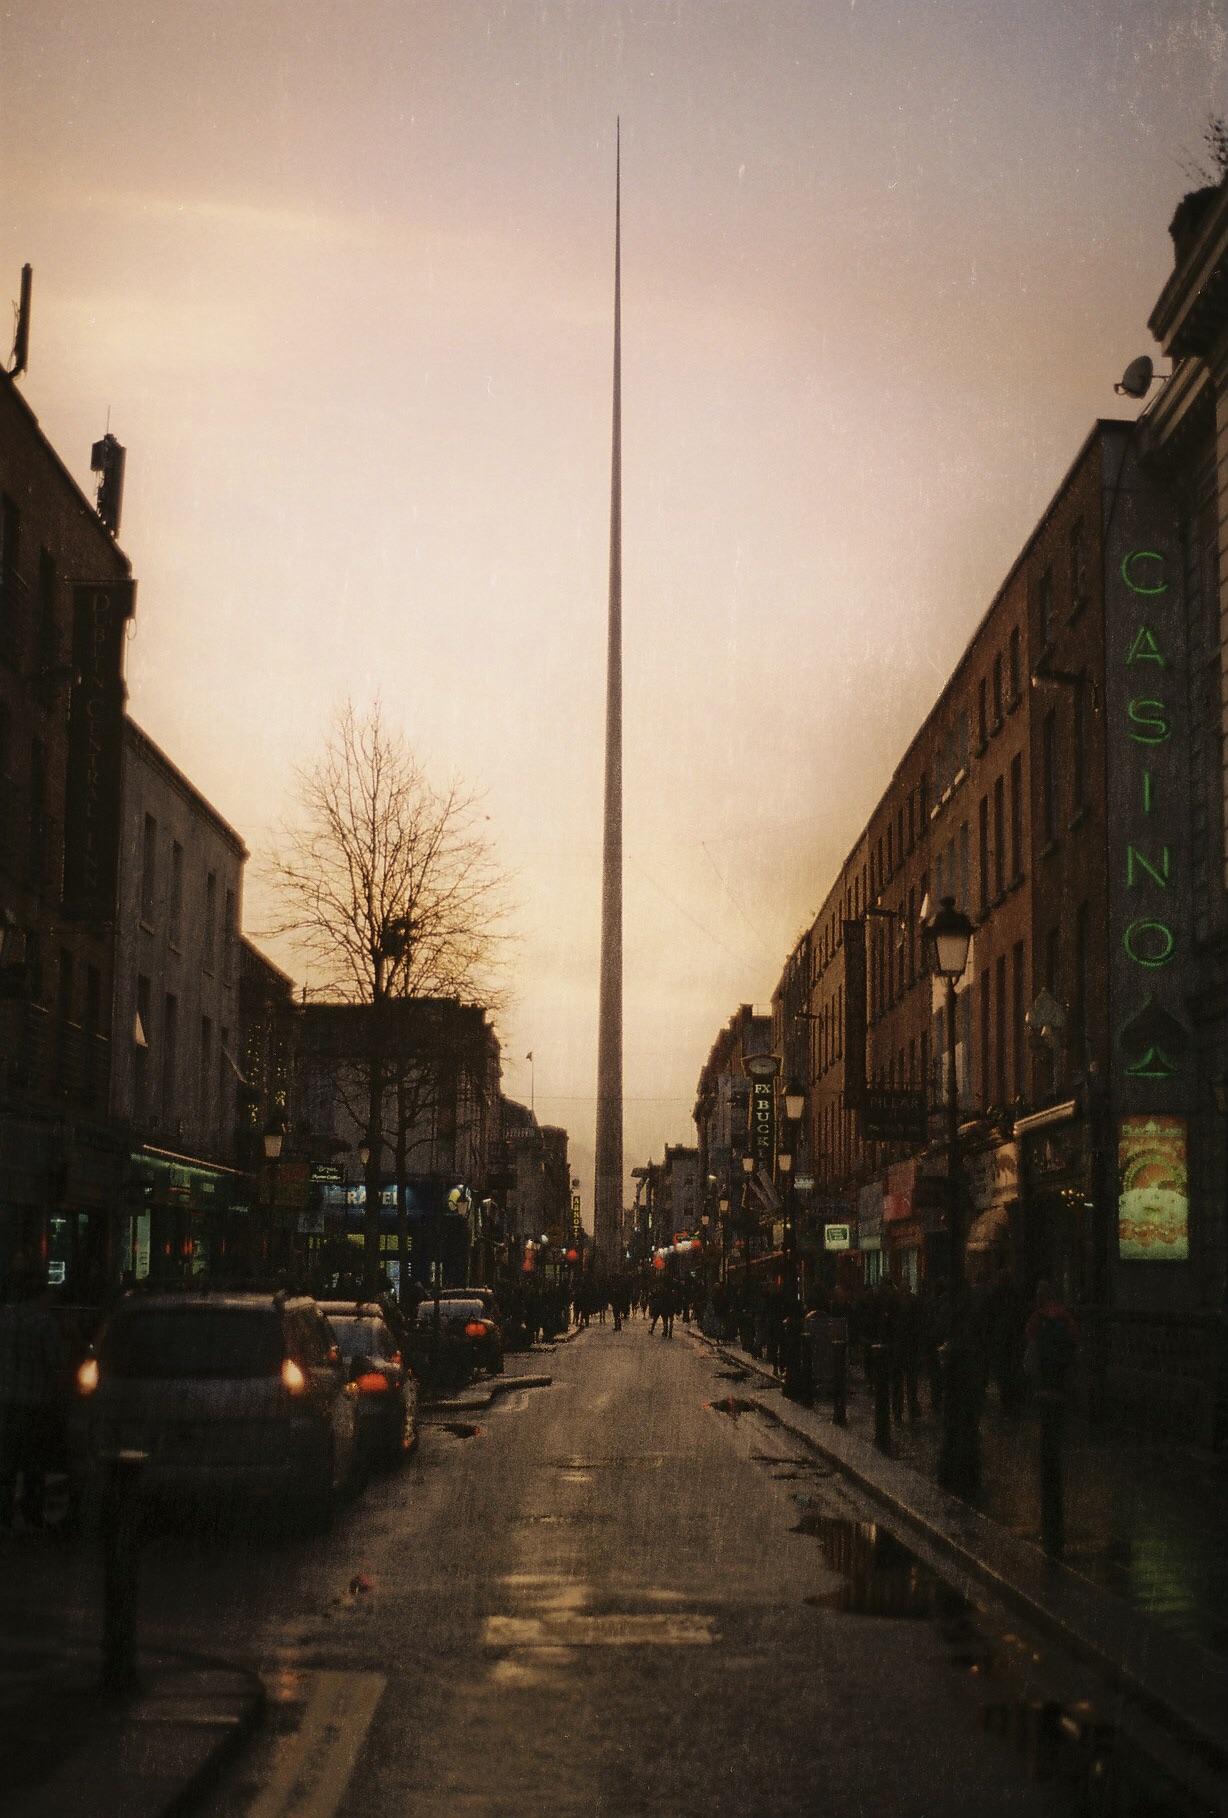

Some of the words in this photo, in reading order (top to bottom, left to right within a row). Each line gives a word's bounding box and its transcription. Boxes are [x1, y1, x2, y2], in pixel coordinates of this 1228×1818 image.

[1121, 551, 1174, 967] CASINO
[754, 1084, 771, 1093] FX
[756, 1099, 770, 1169] BUCKLE
[338, 1190, 399, 1205] RAEL
